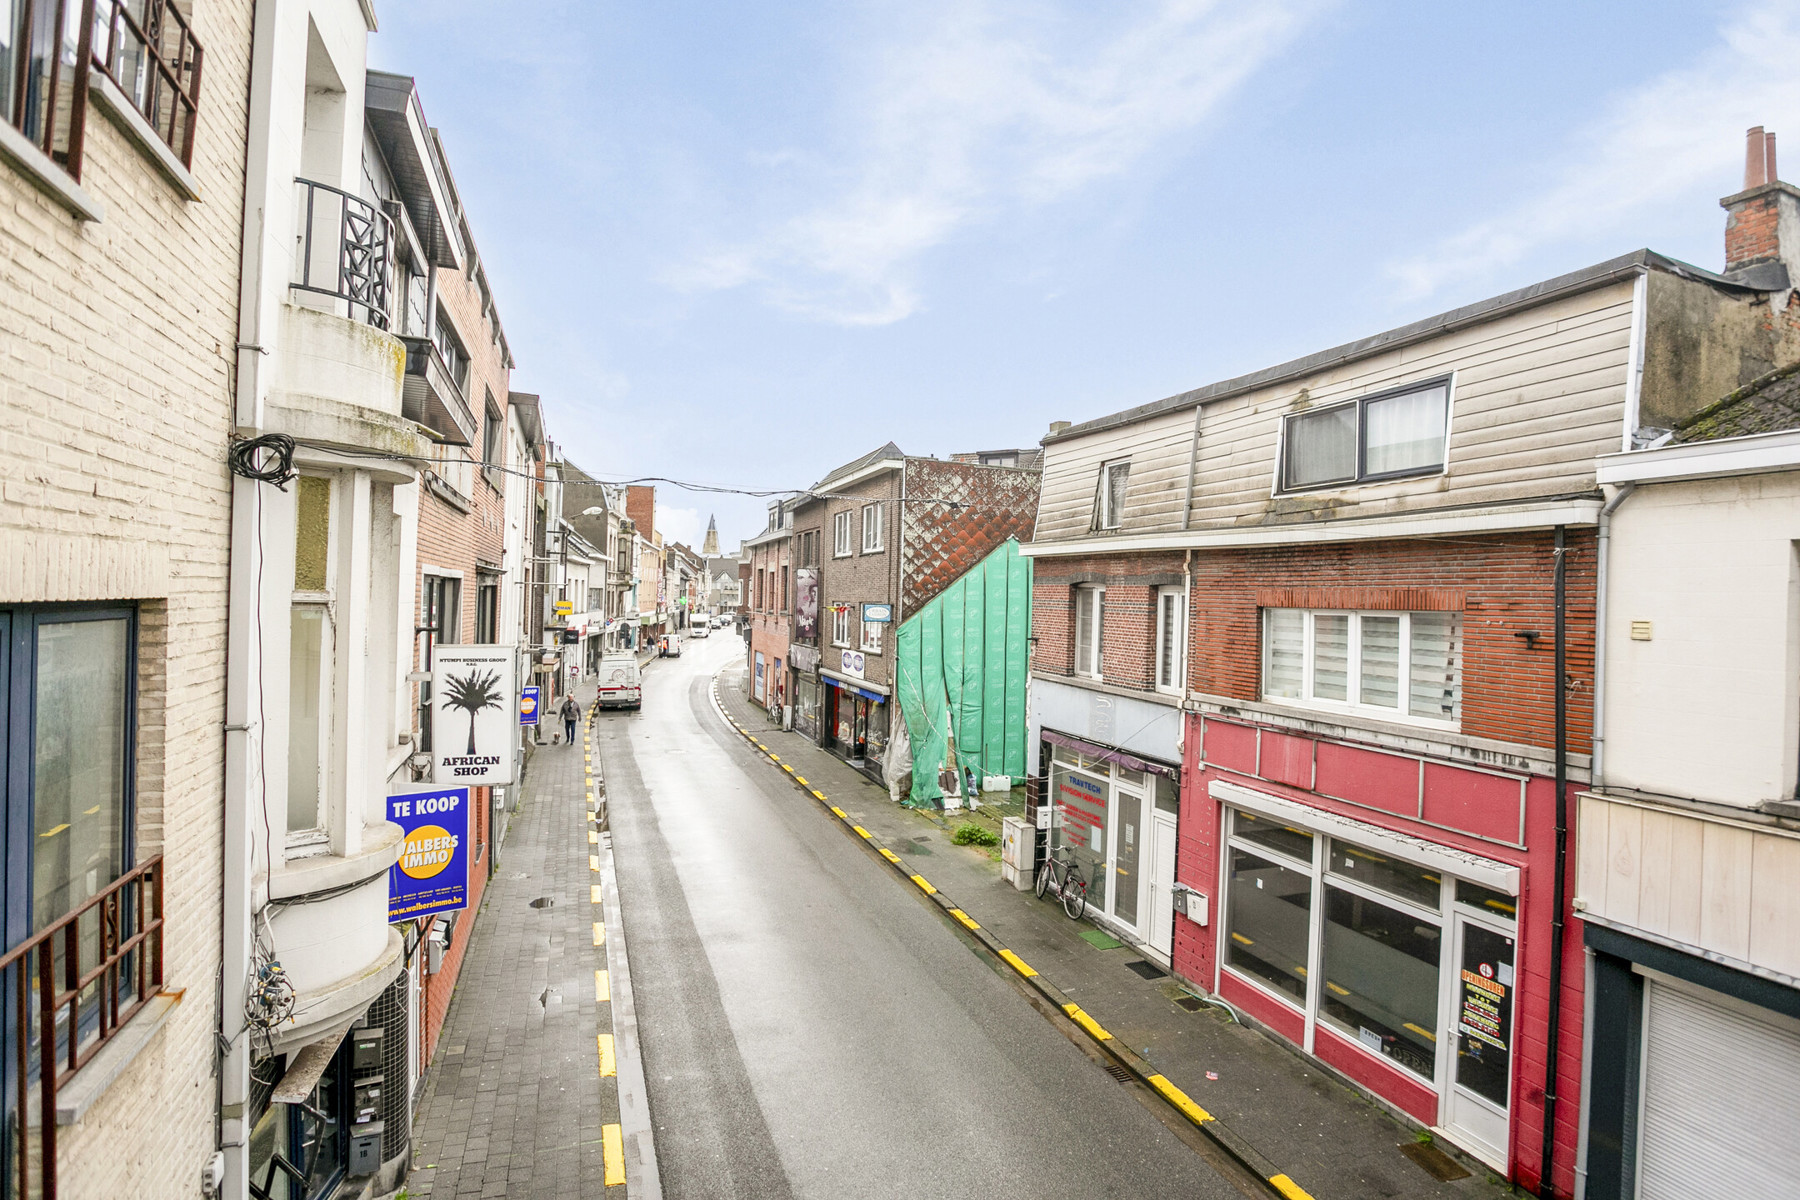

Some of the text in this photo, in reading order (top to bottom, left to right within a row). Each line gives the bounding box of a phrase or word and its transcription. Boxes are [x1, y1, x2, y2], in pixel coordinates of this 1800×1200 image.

[442, 756, 500, 766] AFRICAN
[454, 767, 488, 776] SHOP
[393, 796, 459, 818] TE KOOP
[404, 850, 448, 869] IMMO
[1462, 969, 1505, 998] OPENINGSUREN
[1475, 994, 1490, 1004] TOT
